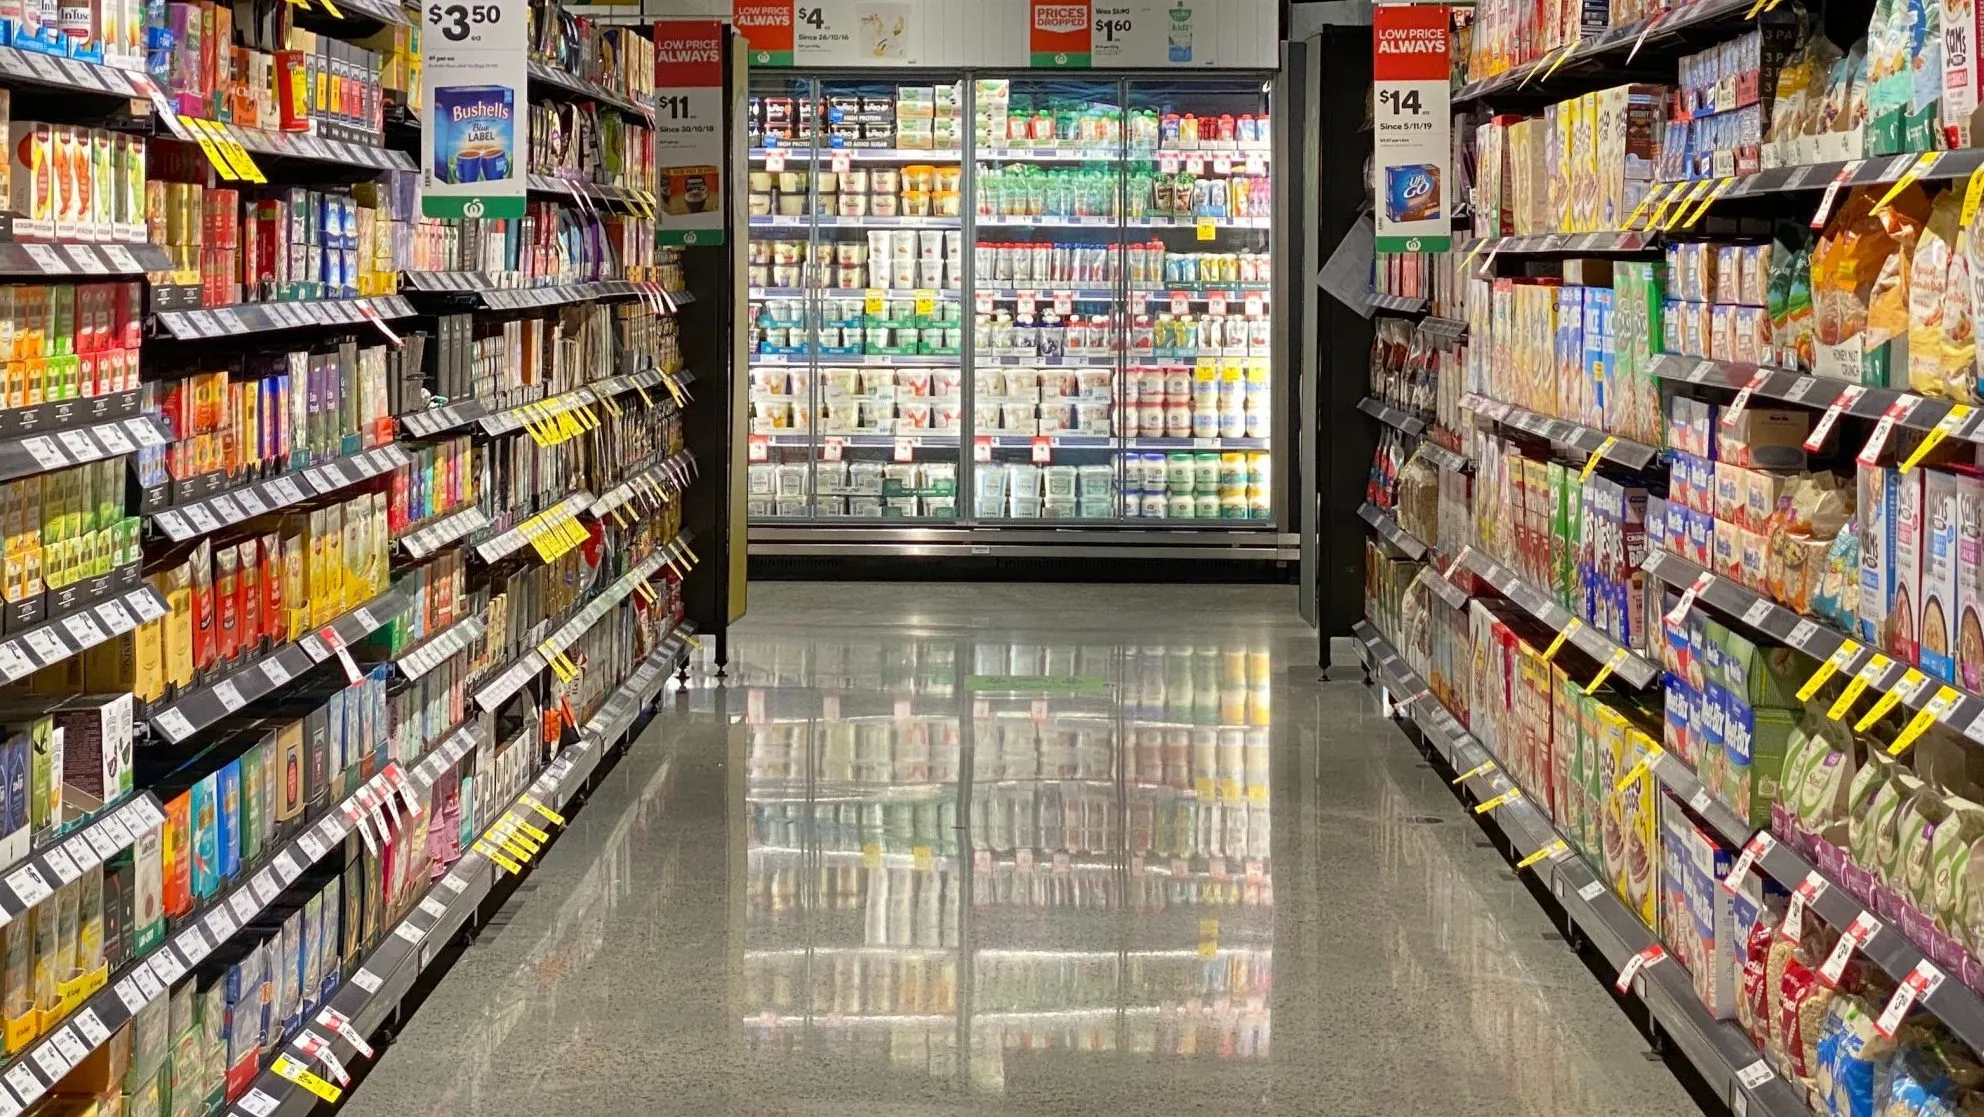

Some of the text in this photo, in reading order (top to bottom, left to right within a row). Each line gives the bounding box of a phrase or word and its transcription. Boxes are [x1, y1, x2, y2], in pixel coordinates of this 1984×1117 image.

[738, 7, 790, 15] LOW PRICE
[1037, 8, 1085, 18] PRICES
[738, 15, 790, 26] ALWAYS
[798, 8, 824, 30] $4
[1037, 18, 1085, 27] DROPPED
[1379, 29, 1445, 39] LOW PRICE
[658, 40, 719, 49] LOW PRICE
[1378, 41, 1445, 54] ALWAYS
[657, 50, 720, 62] ALWAYS
[659, 95, 689, 119] $11
[1380, 89, 1422, 115] $14
[453, 101, 509, 121] Bushells
[472, 122, 490, 132] Blue
[468, 132, 495, 141] LABEL
[1403, 182, 1430, 198] GO
